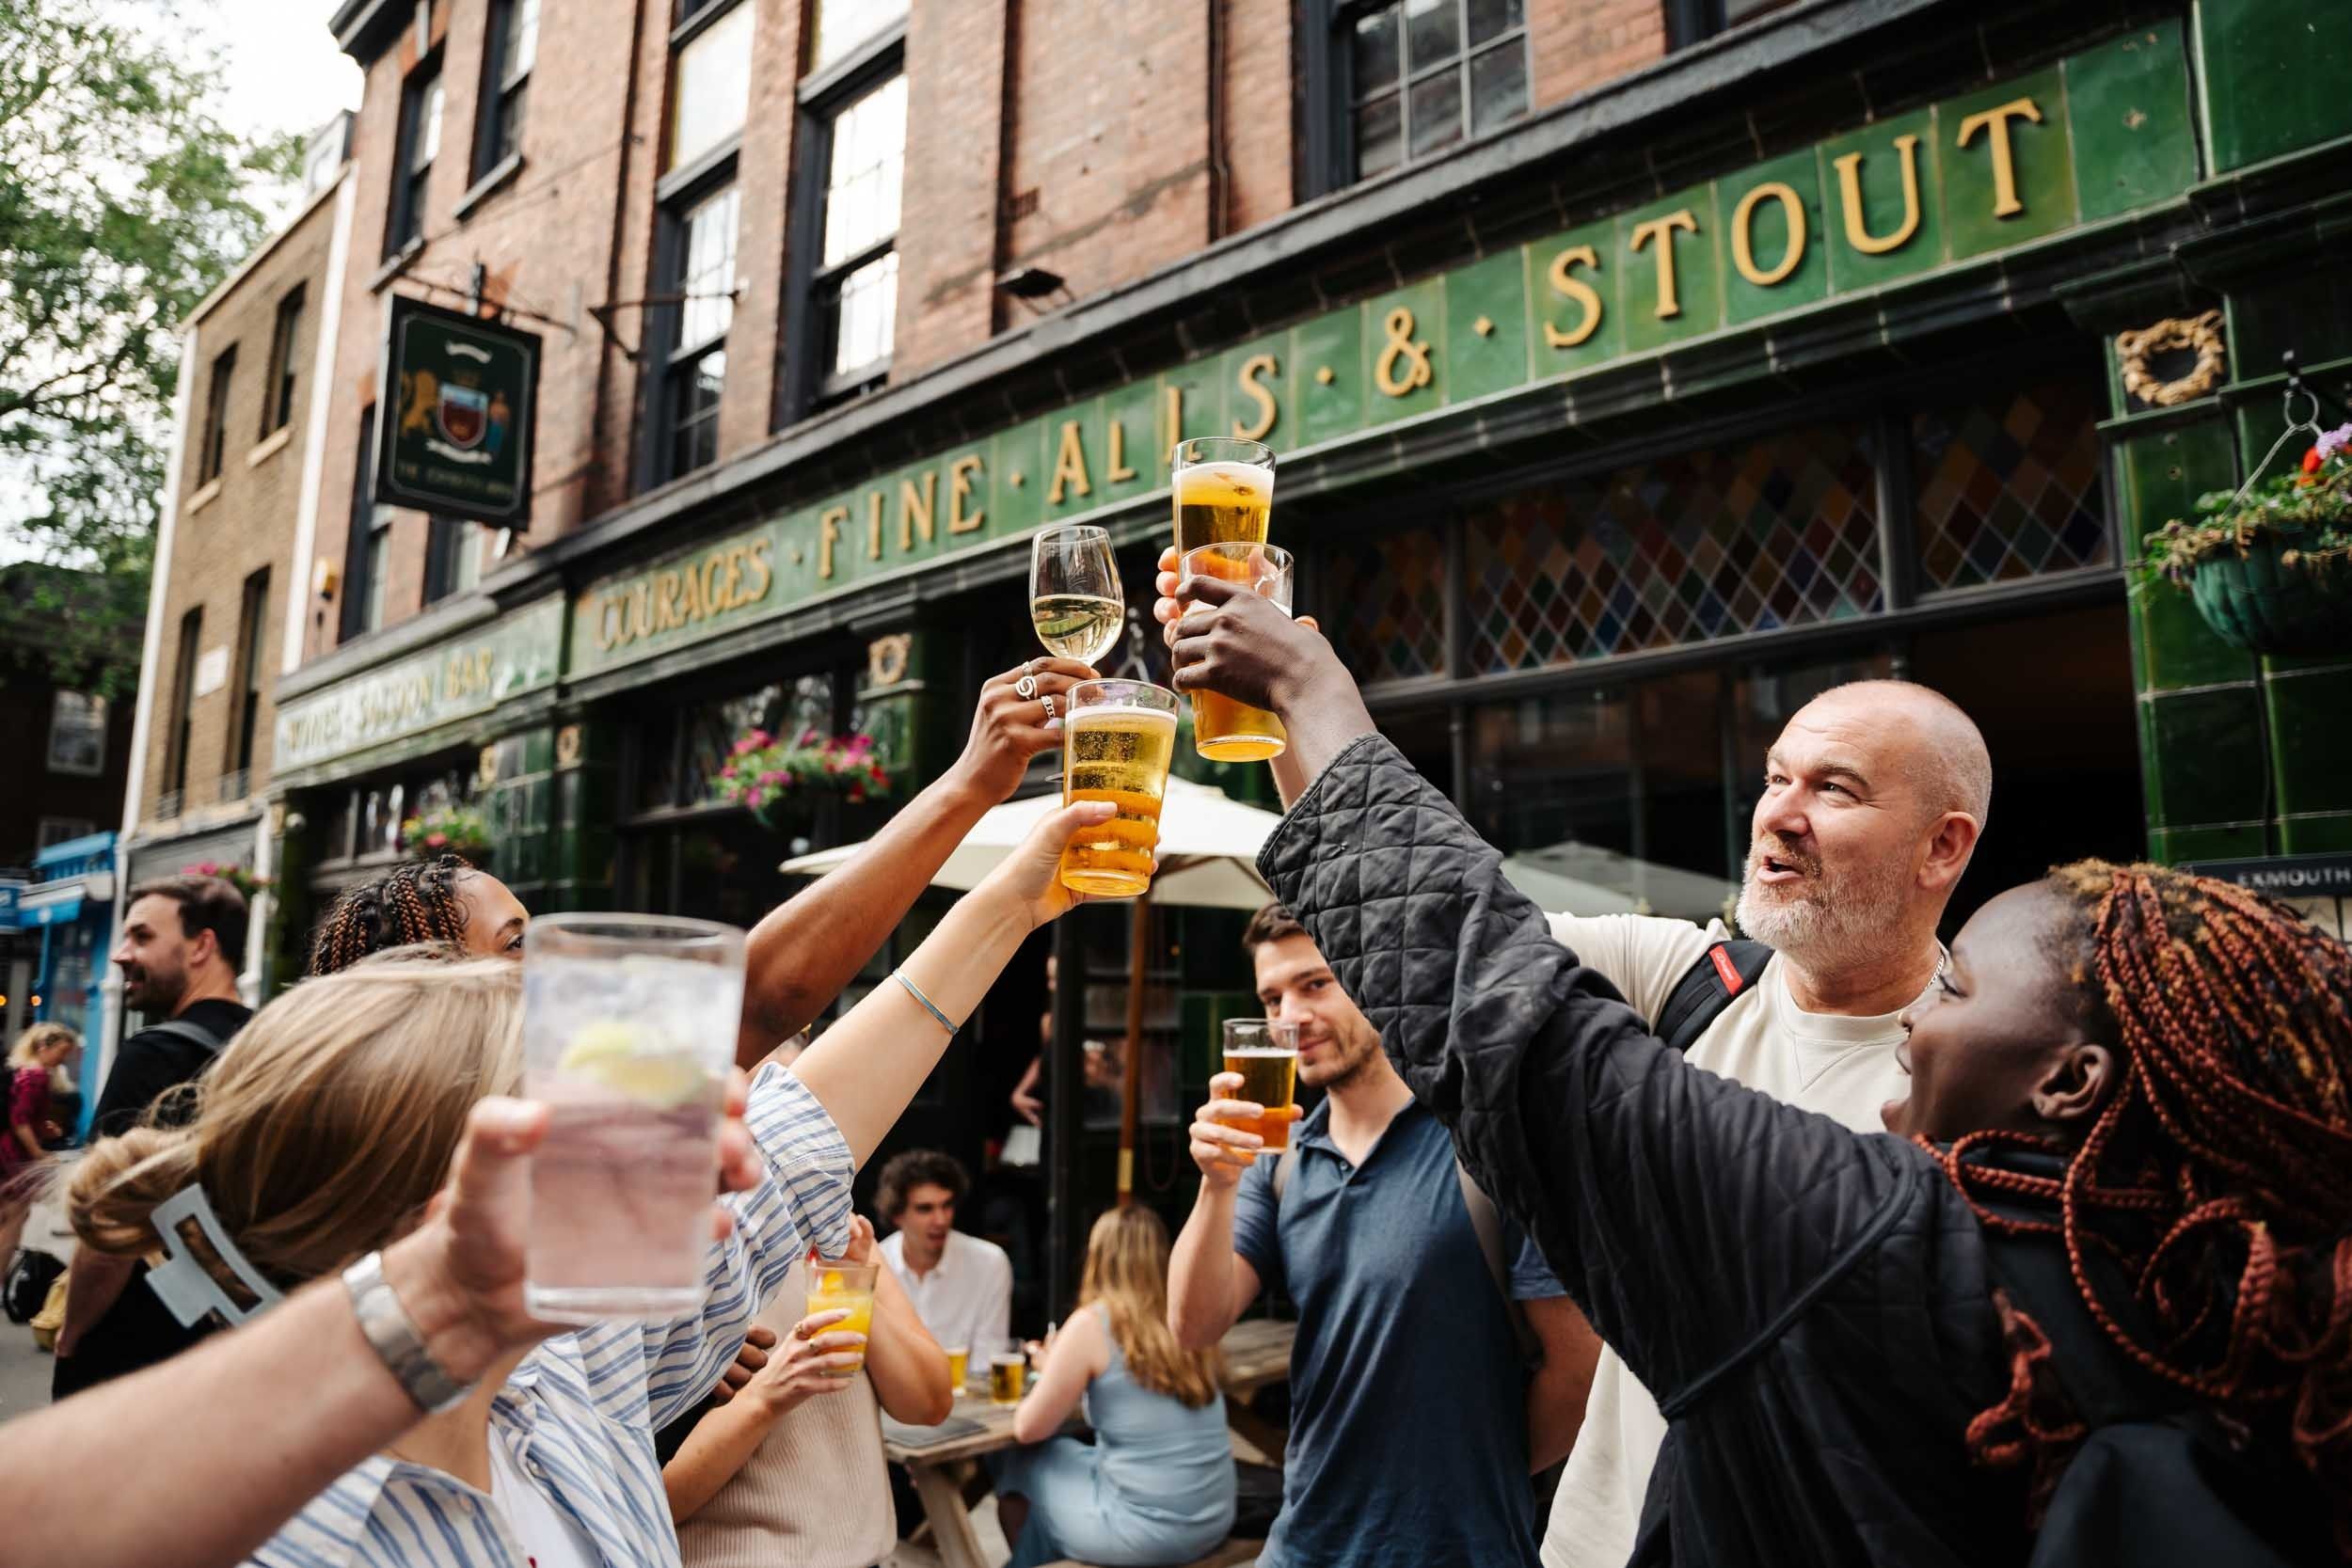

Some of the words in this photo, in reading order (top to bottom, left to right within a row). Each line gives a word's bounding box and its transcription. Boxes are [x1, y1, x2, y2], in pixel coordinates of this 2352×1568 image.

[594, 536, 772, 653] COURAGES
[818, 454, 984, 580] FINE
[1375, 306, 1432, 397] &
[1544, 97, 2043, 348] STOUT
